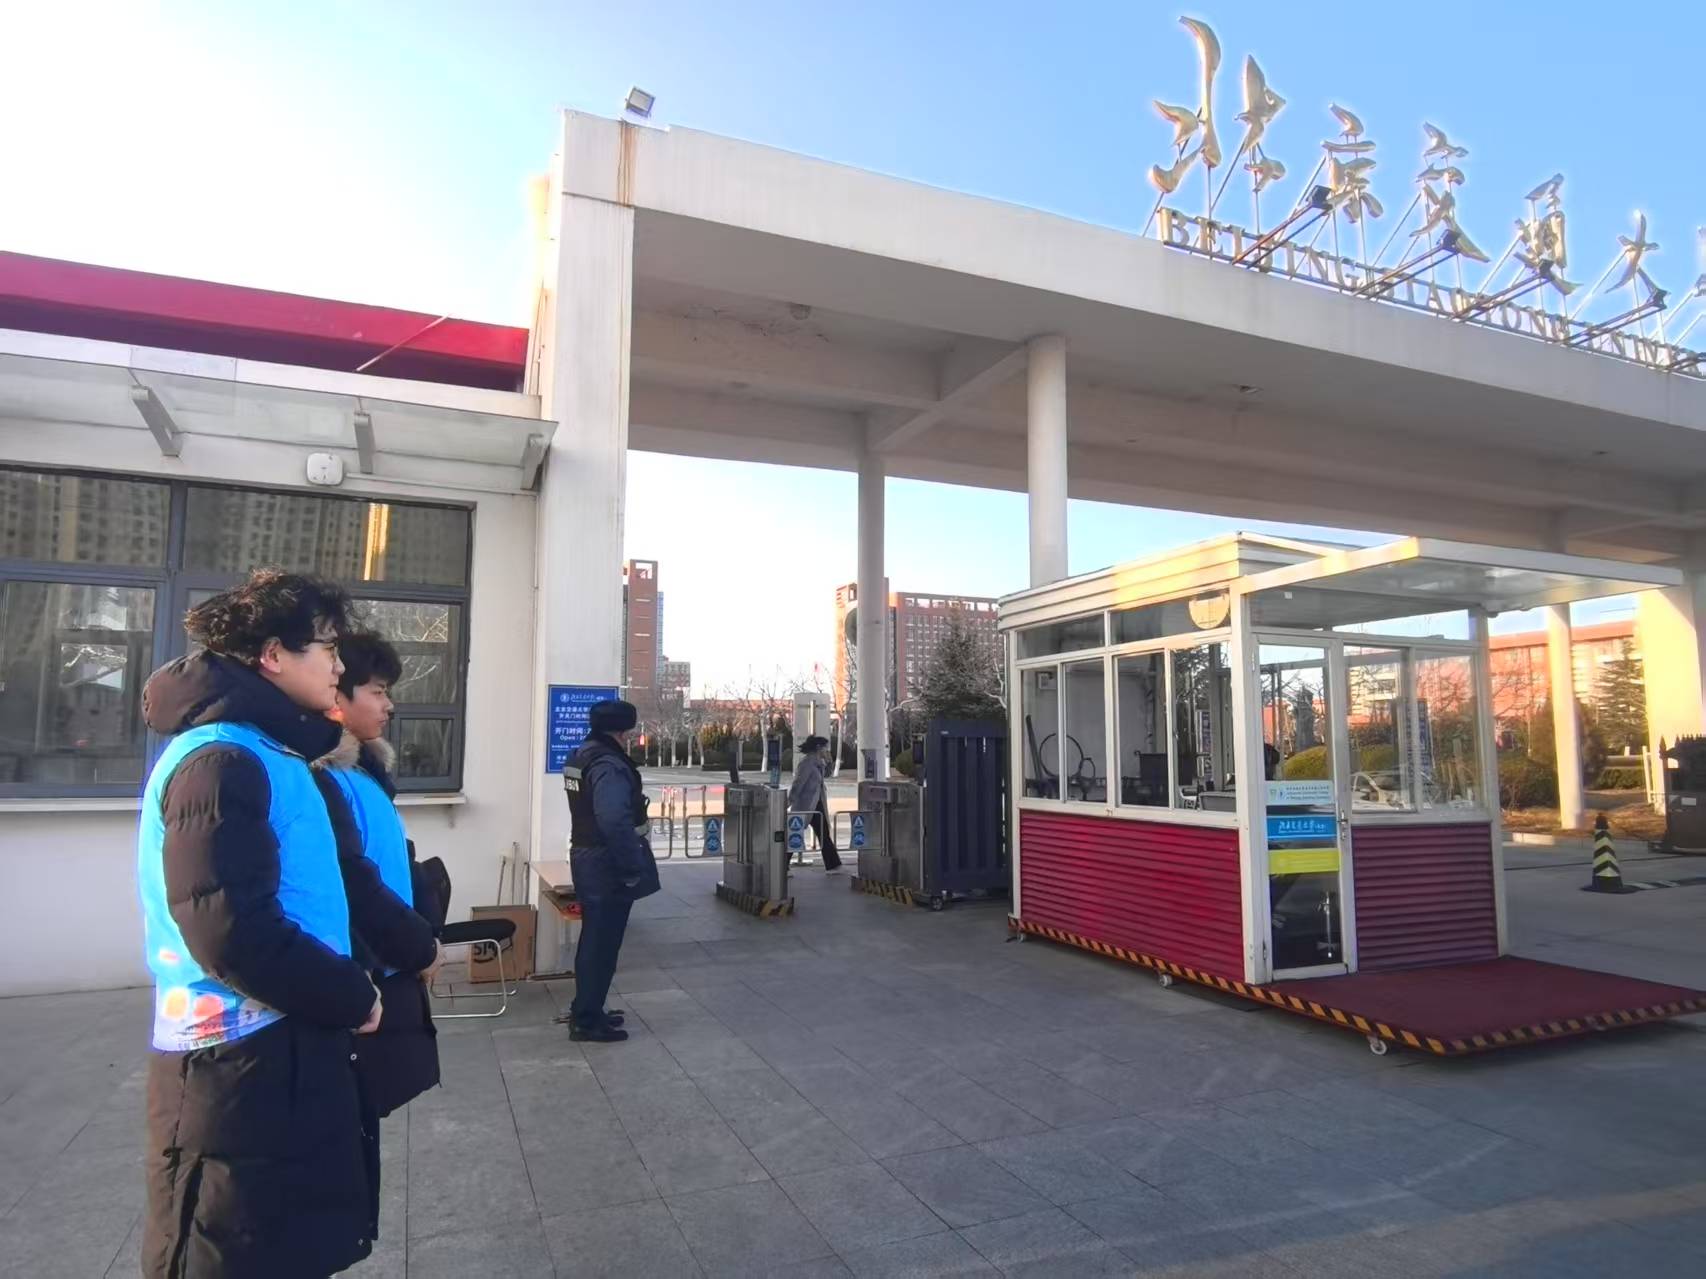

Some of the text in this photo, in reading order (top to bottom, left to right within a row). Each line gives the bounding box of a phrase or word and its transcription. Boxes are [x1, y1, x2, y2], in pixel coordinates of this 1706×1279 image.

[1148, 15, 1706, 306] 北京交通大
